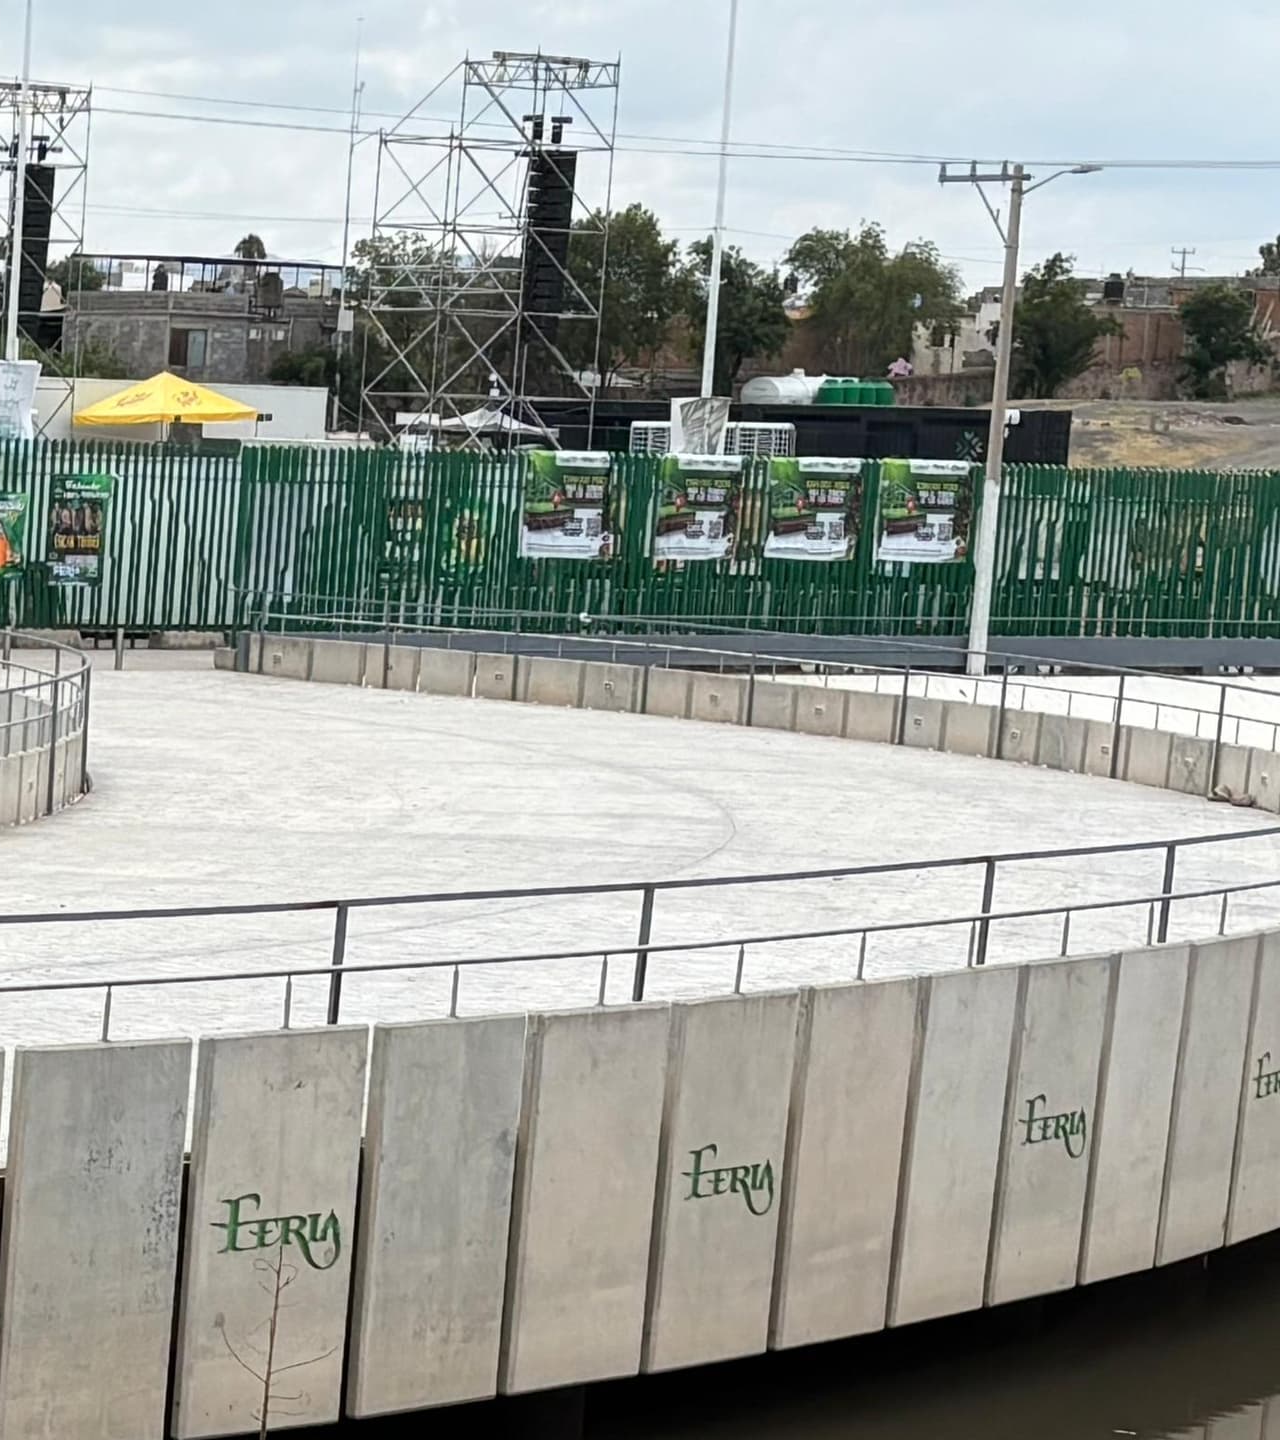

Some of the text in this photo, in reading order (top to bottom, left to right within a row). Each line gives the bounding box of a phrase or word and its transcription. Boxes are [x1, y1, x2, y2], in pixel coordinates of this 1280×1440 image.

[1018, 1093, 1087, 1159] FERIA
[681, 1143, 776, 1217] FERIA
[210, 1192, 343, 1271] FERIA
